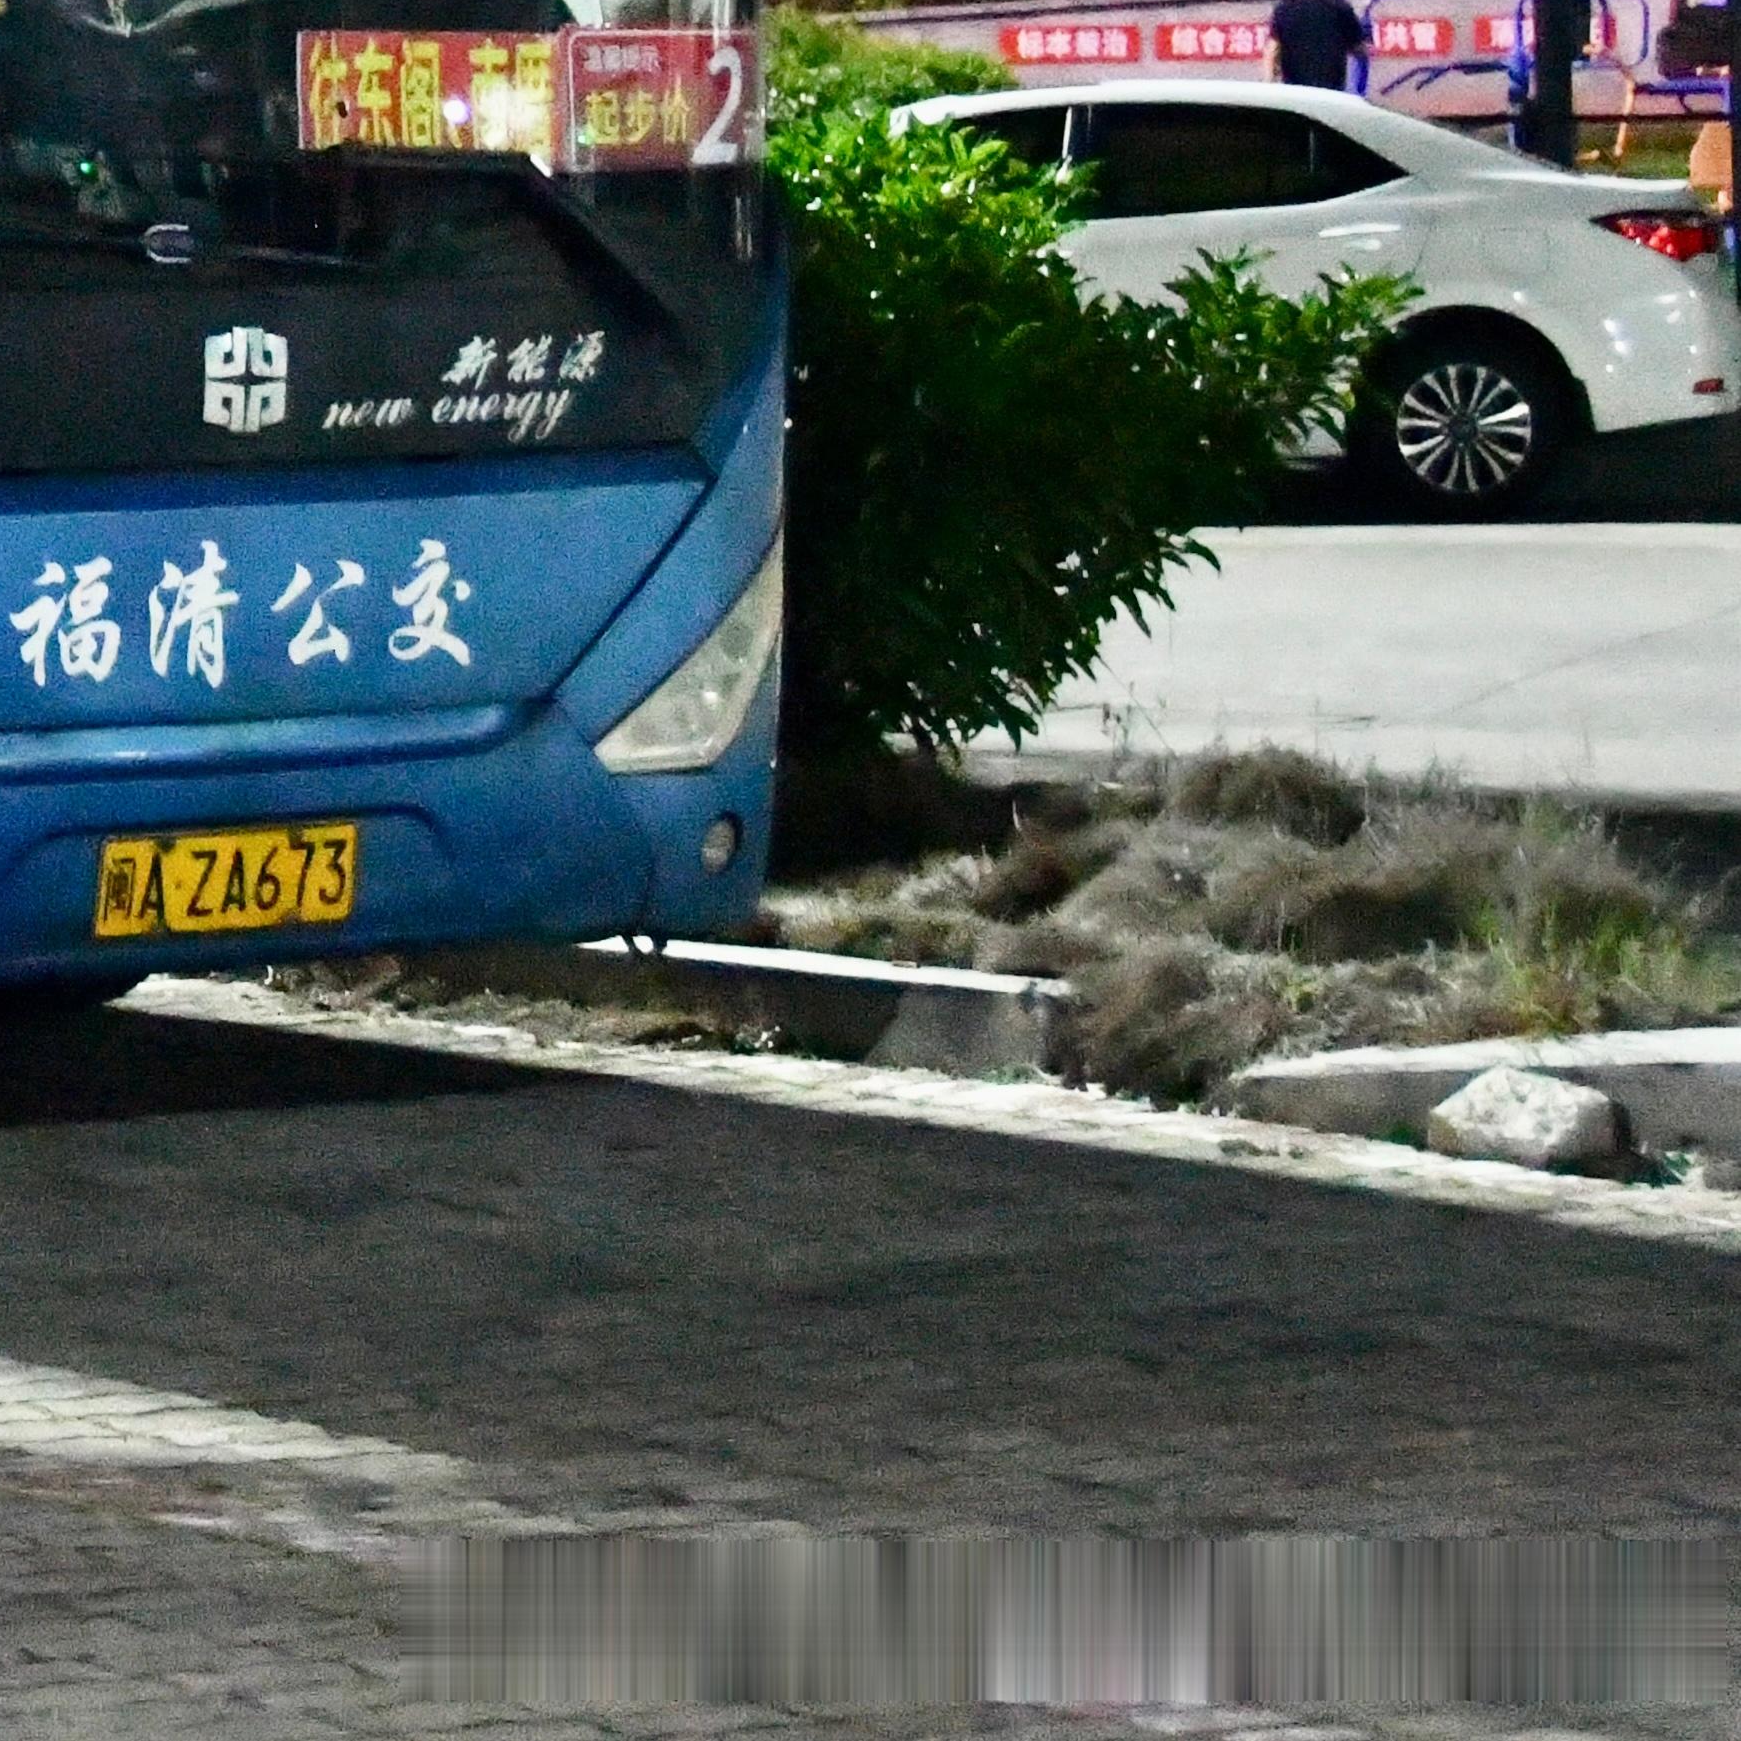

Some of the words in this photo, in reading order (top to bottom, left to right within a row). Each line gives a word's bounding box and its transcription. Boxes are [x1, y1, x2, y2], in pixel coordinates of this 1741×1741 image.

[584, 75, 690, 145] 起步价
[441, 330, 605, 390] 新能源
[322, 397, 413, 430] new
[430, 388, 571, 443] energy
[9, 538, 473, 689] 福清公交
